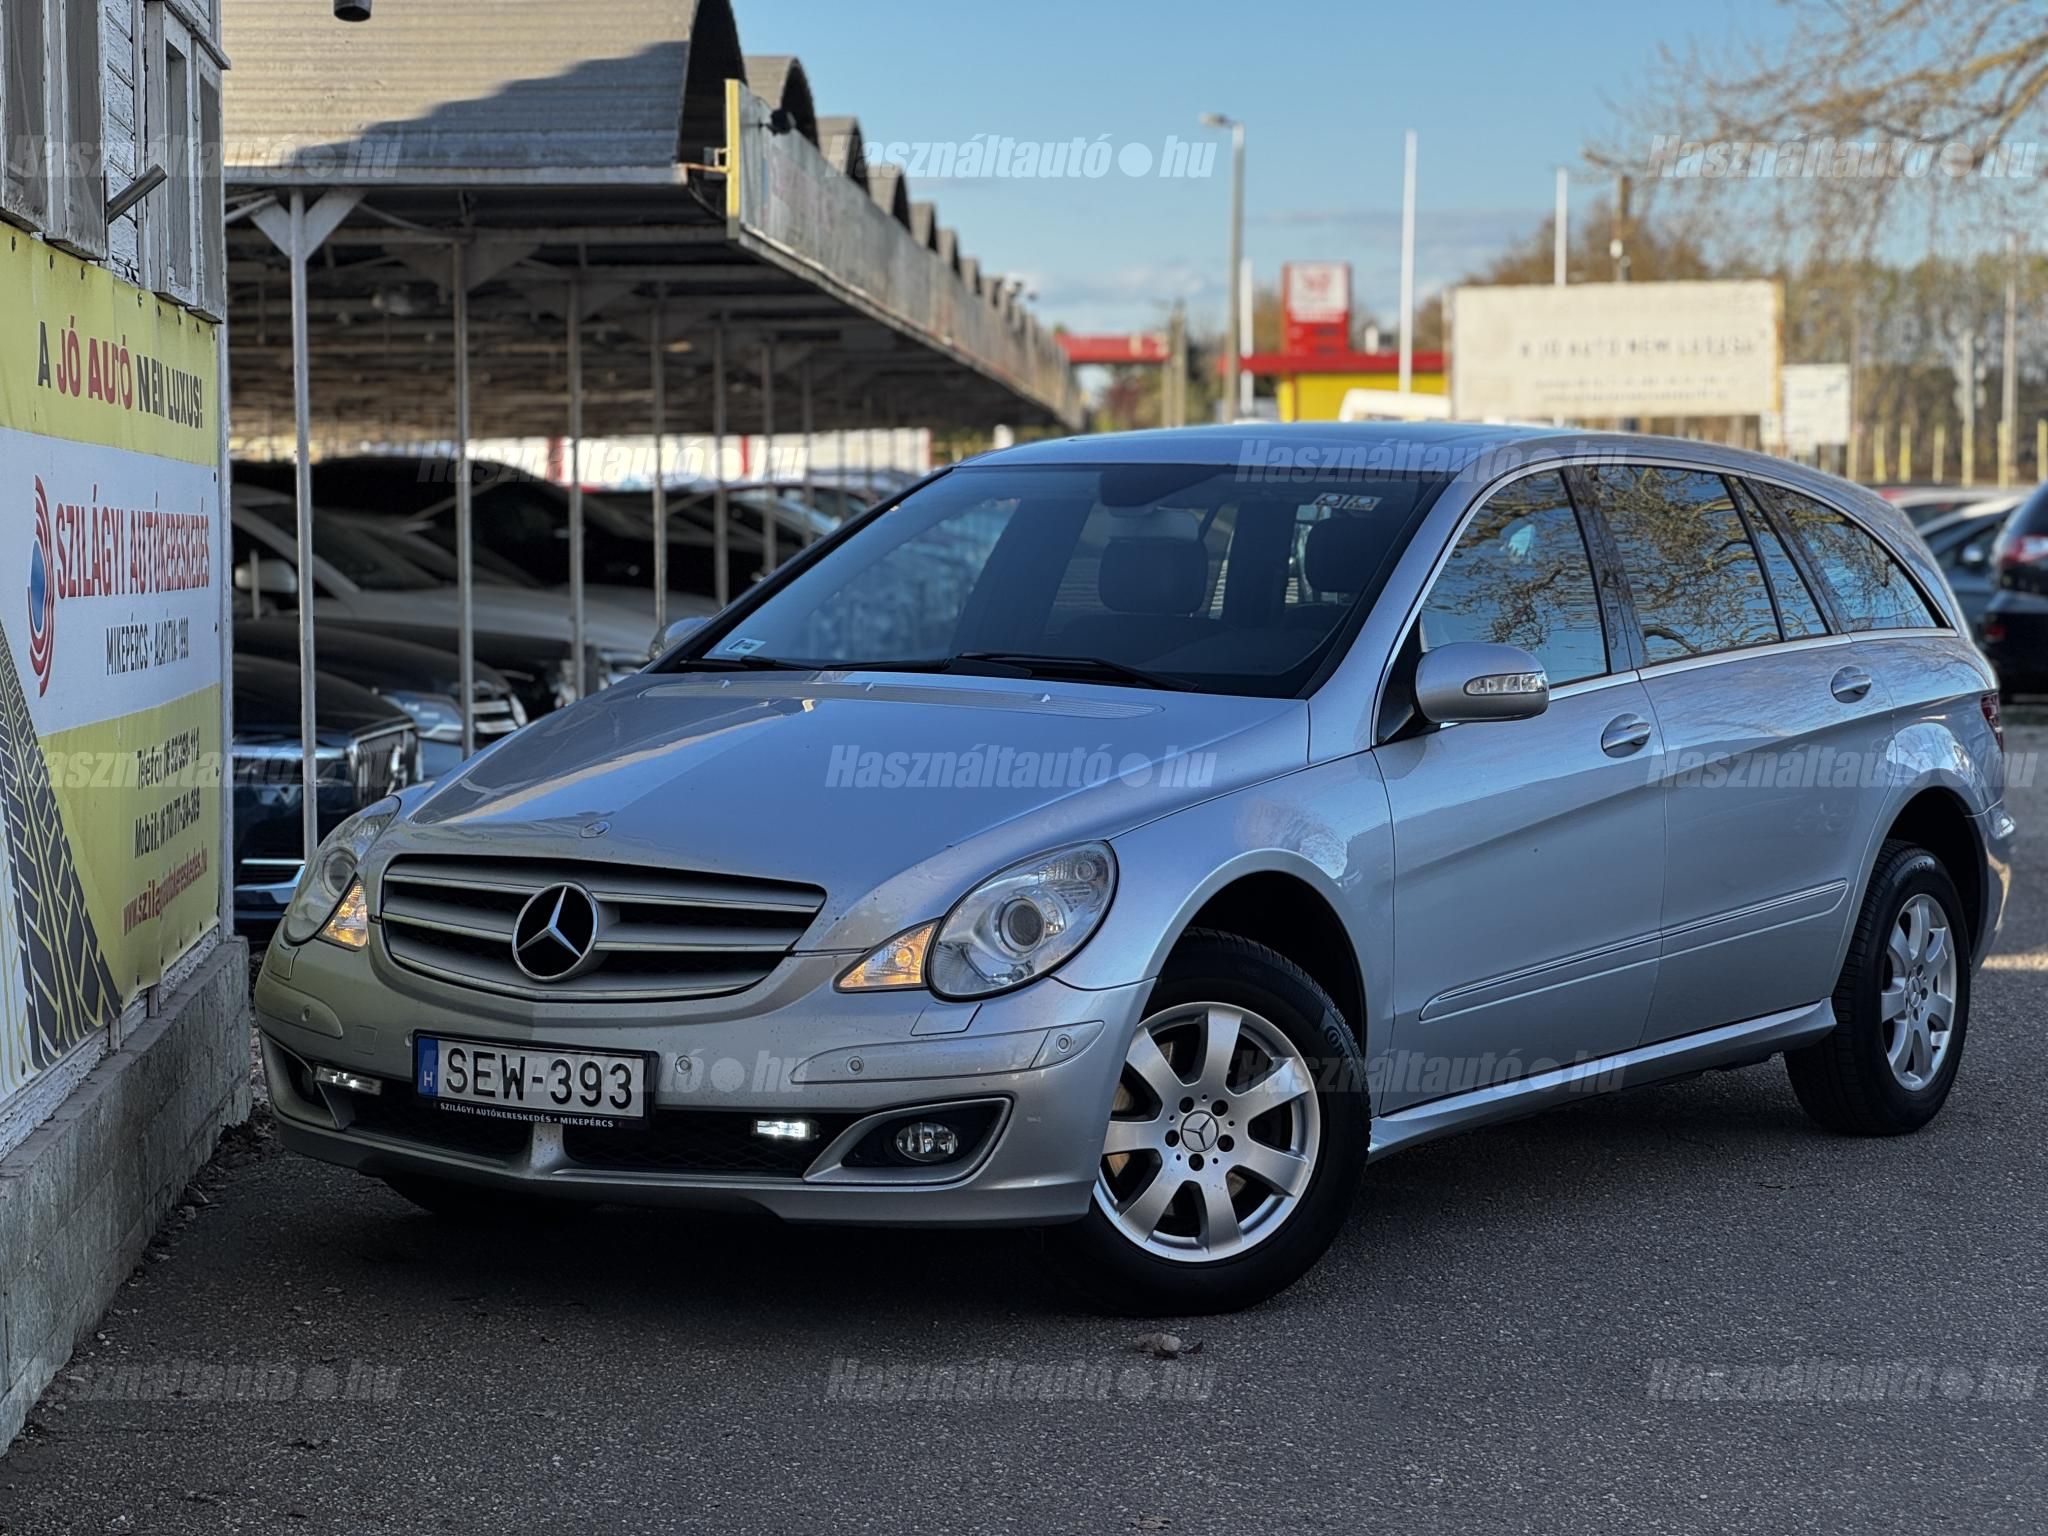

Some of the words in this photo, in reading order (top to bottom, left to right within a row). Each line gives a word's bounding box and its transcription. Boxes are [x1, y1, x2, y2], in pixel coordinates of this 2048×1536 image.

[37, 321, 51, 389] A
[56, 315, 81, 398] JÓ
[165, 365, 203, 429] LUXUS!
[56, 484, 125, 600] SZILÁGYI
[130, 491, 210, 594] AUTÓKERESKEDÉS
[106, 612, 149, 676] MIKEPÉRCS
[423, 1070, 433, 1088] H
[446, 1047, 632, 1110] SEW-393
[440, 1101, 475, 1115] SZILÁGYI
[476, 1106, 551, 1123] AUTÓKERESKEDÉS
[560, 1115, 614, 1128] MIKEPÉRCS
